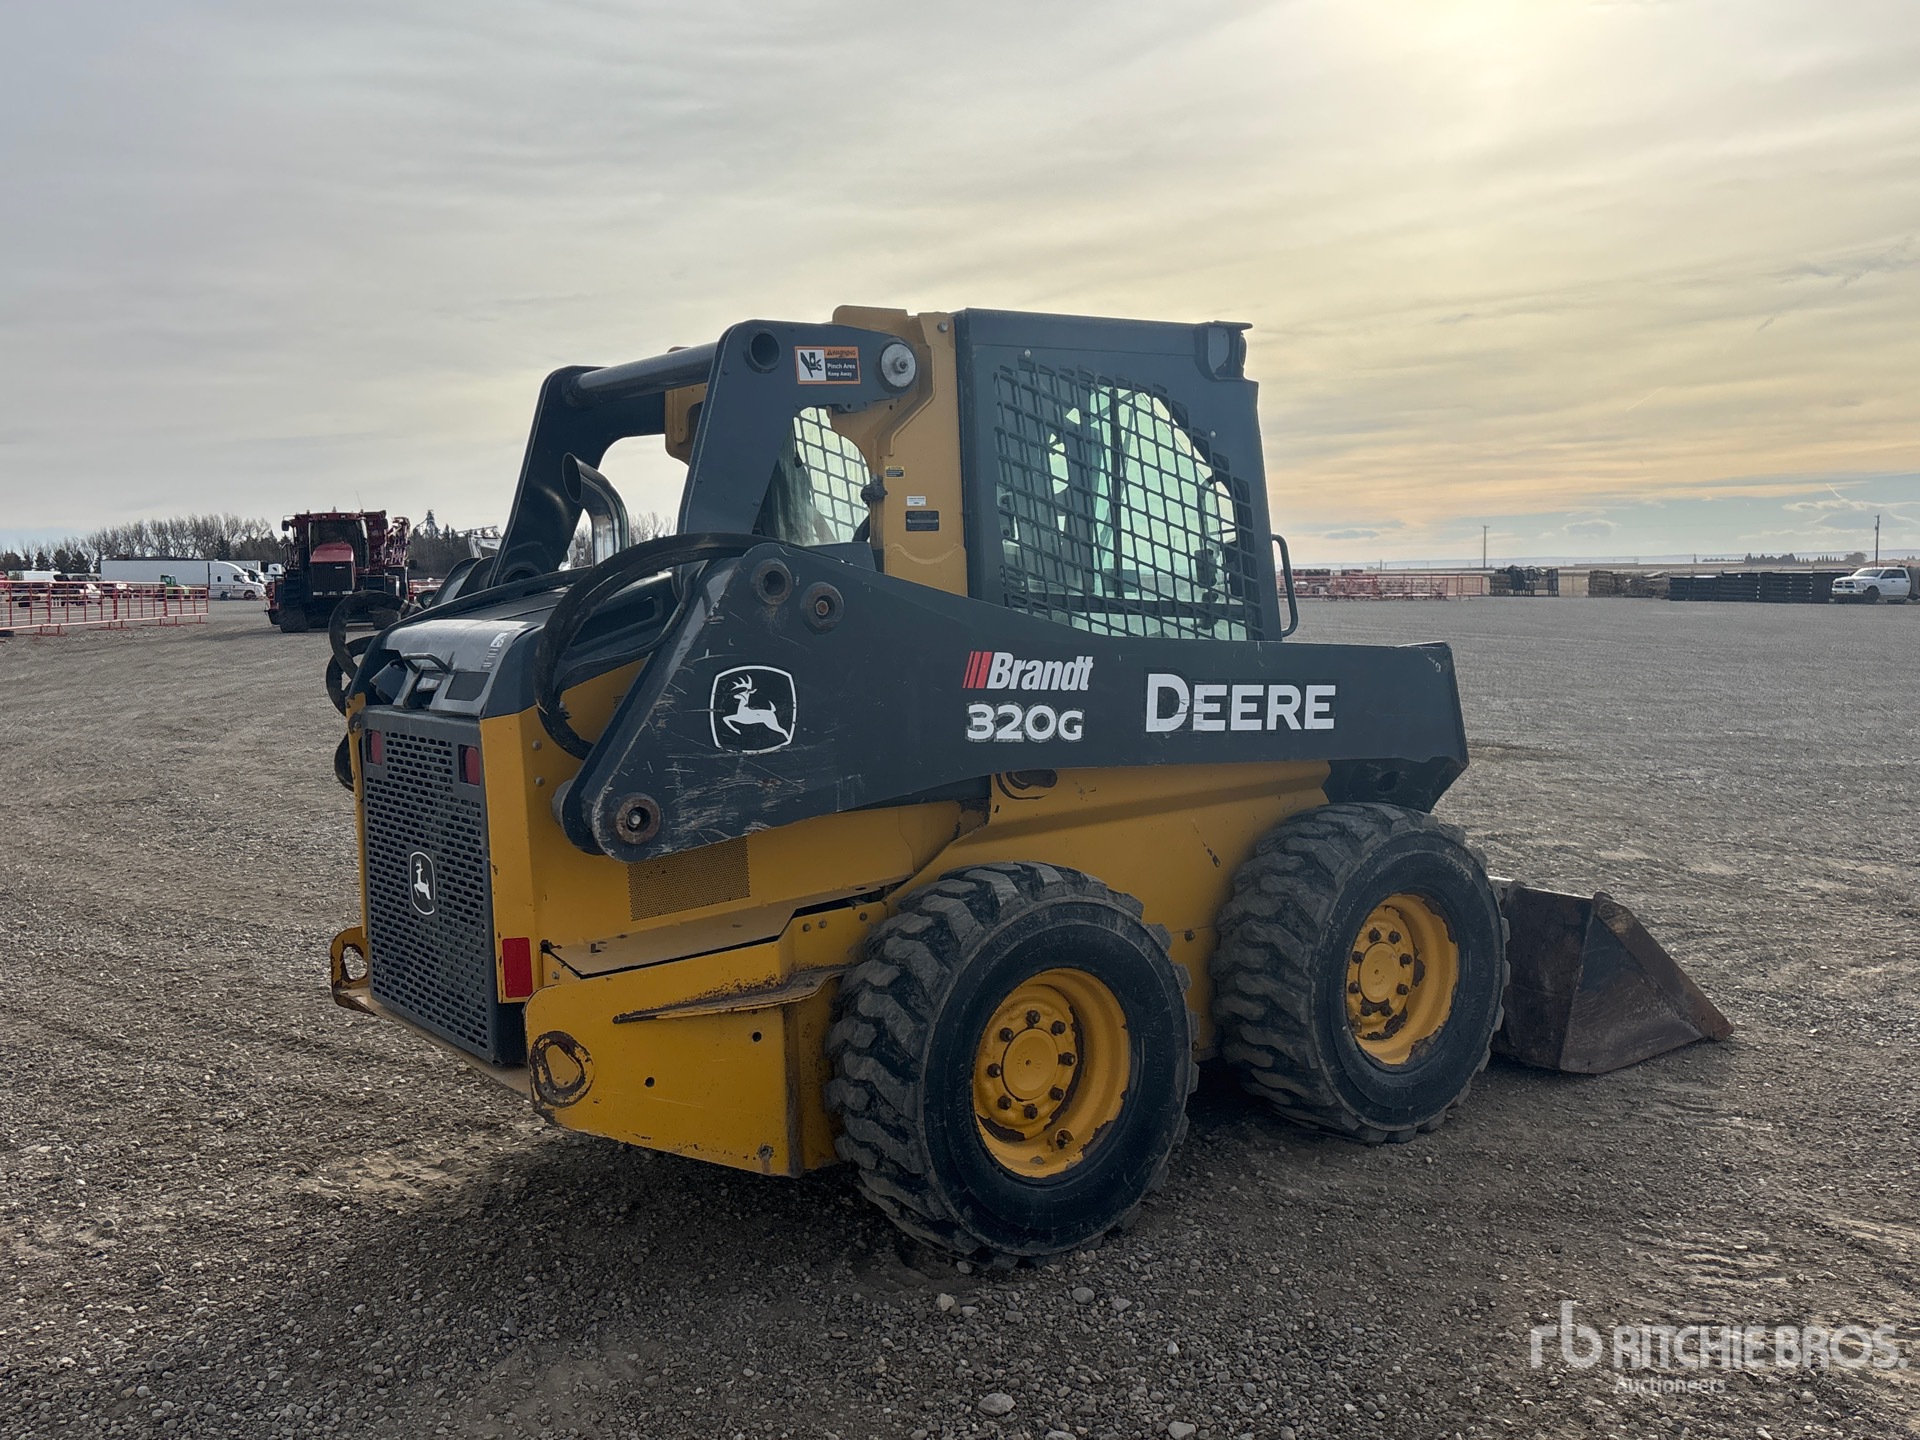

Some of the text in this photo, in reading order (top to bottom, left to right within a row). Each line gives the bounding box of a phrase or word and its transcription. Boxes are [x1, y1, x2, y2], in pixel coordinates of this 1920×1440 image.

[987, 651, 1094, 691] Brandt
[967, 704, 1084, 741] 320G
[1145, 673, 1337, 733] DEERE
